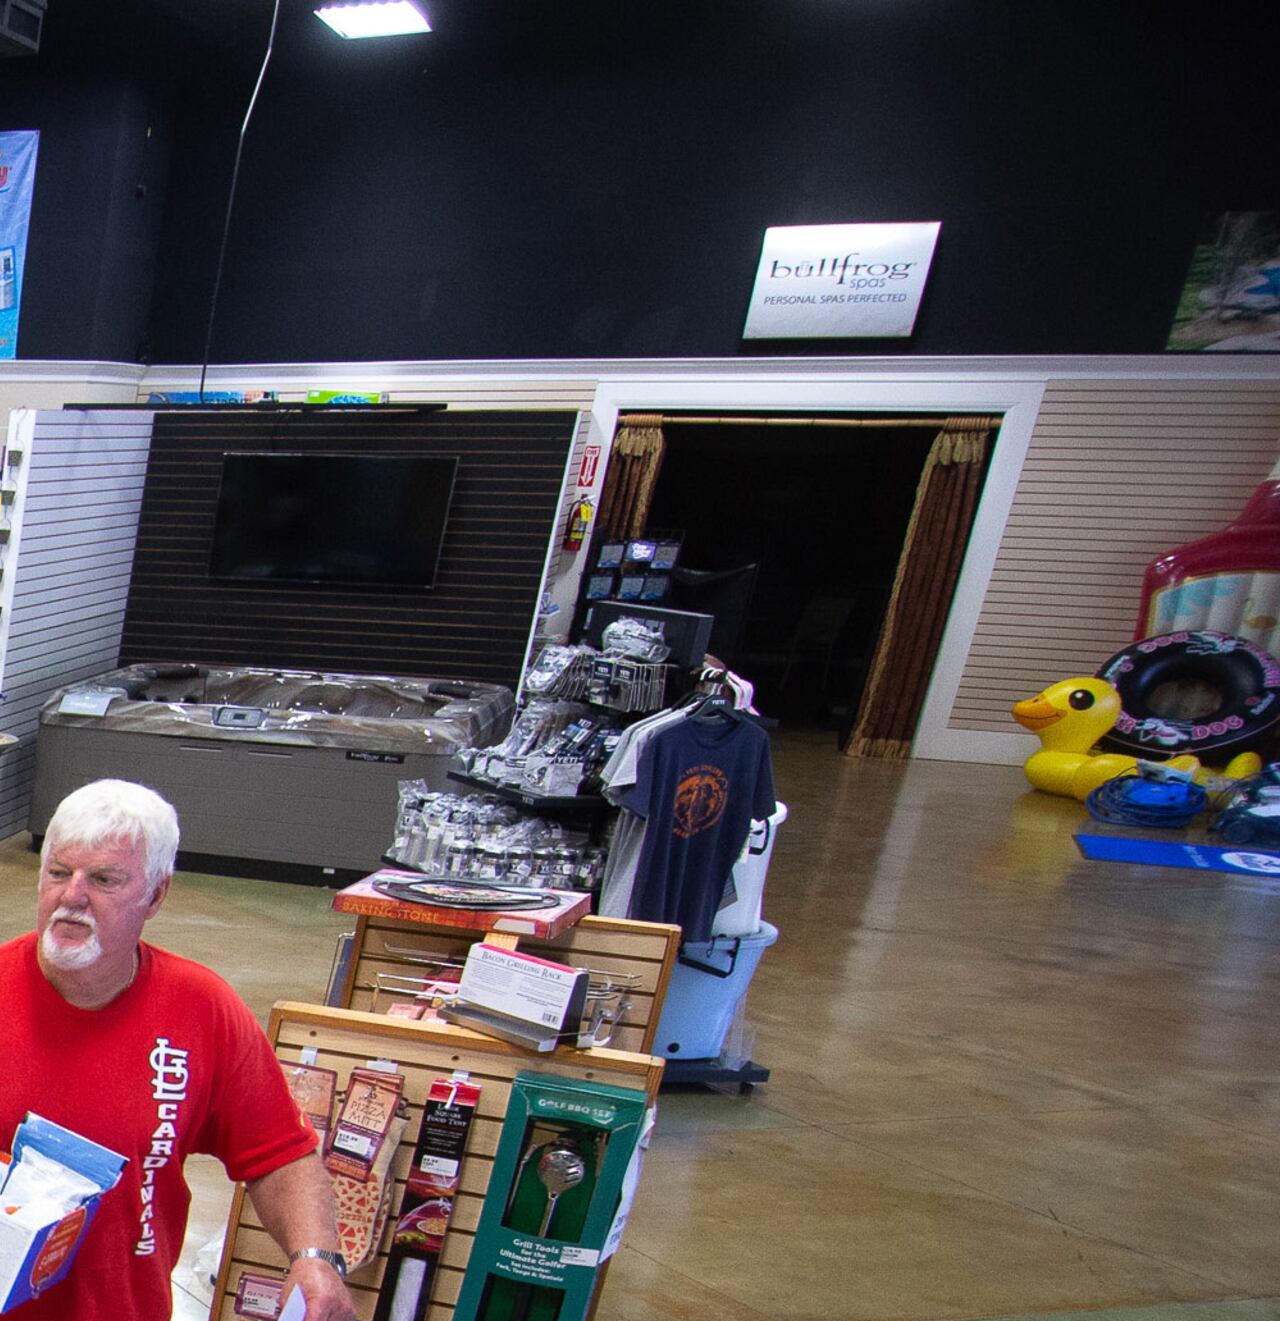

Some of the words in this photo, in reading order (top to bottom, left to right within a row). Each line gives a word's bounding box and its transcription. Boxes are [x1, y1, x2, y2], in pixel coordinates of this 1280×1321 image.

[849, 278, 886, 290] spas
[764, 295, 816, 305] PERSONAL
[820, 294, 845, 304] SPAS
[847, 293, 907, 303] PERFECTED
[557, 756, 578, 764] YETI
[350, 1101, 386, 1120] PIZZA
[567, 1104, 591, 1113] BBQ
[348, 1111, 382, 1128] MITT
[135, 1103, 178, 1255] CARDINALS
[512, 1238, 532, 1249] Grill
[535, 1243, 559, 1254] Tools
[500, 1248, 536, 1264] Ultimate
[538, 1258, 566, 1269] Golfer
